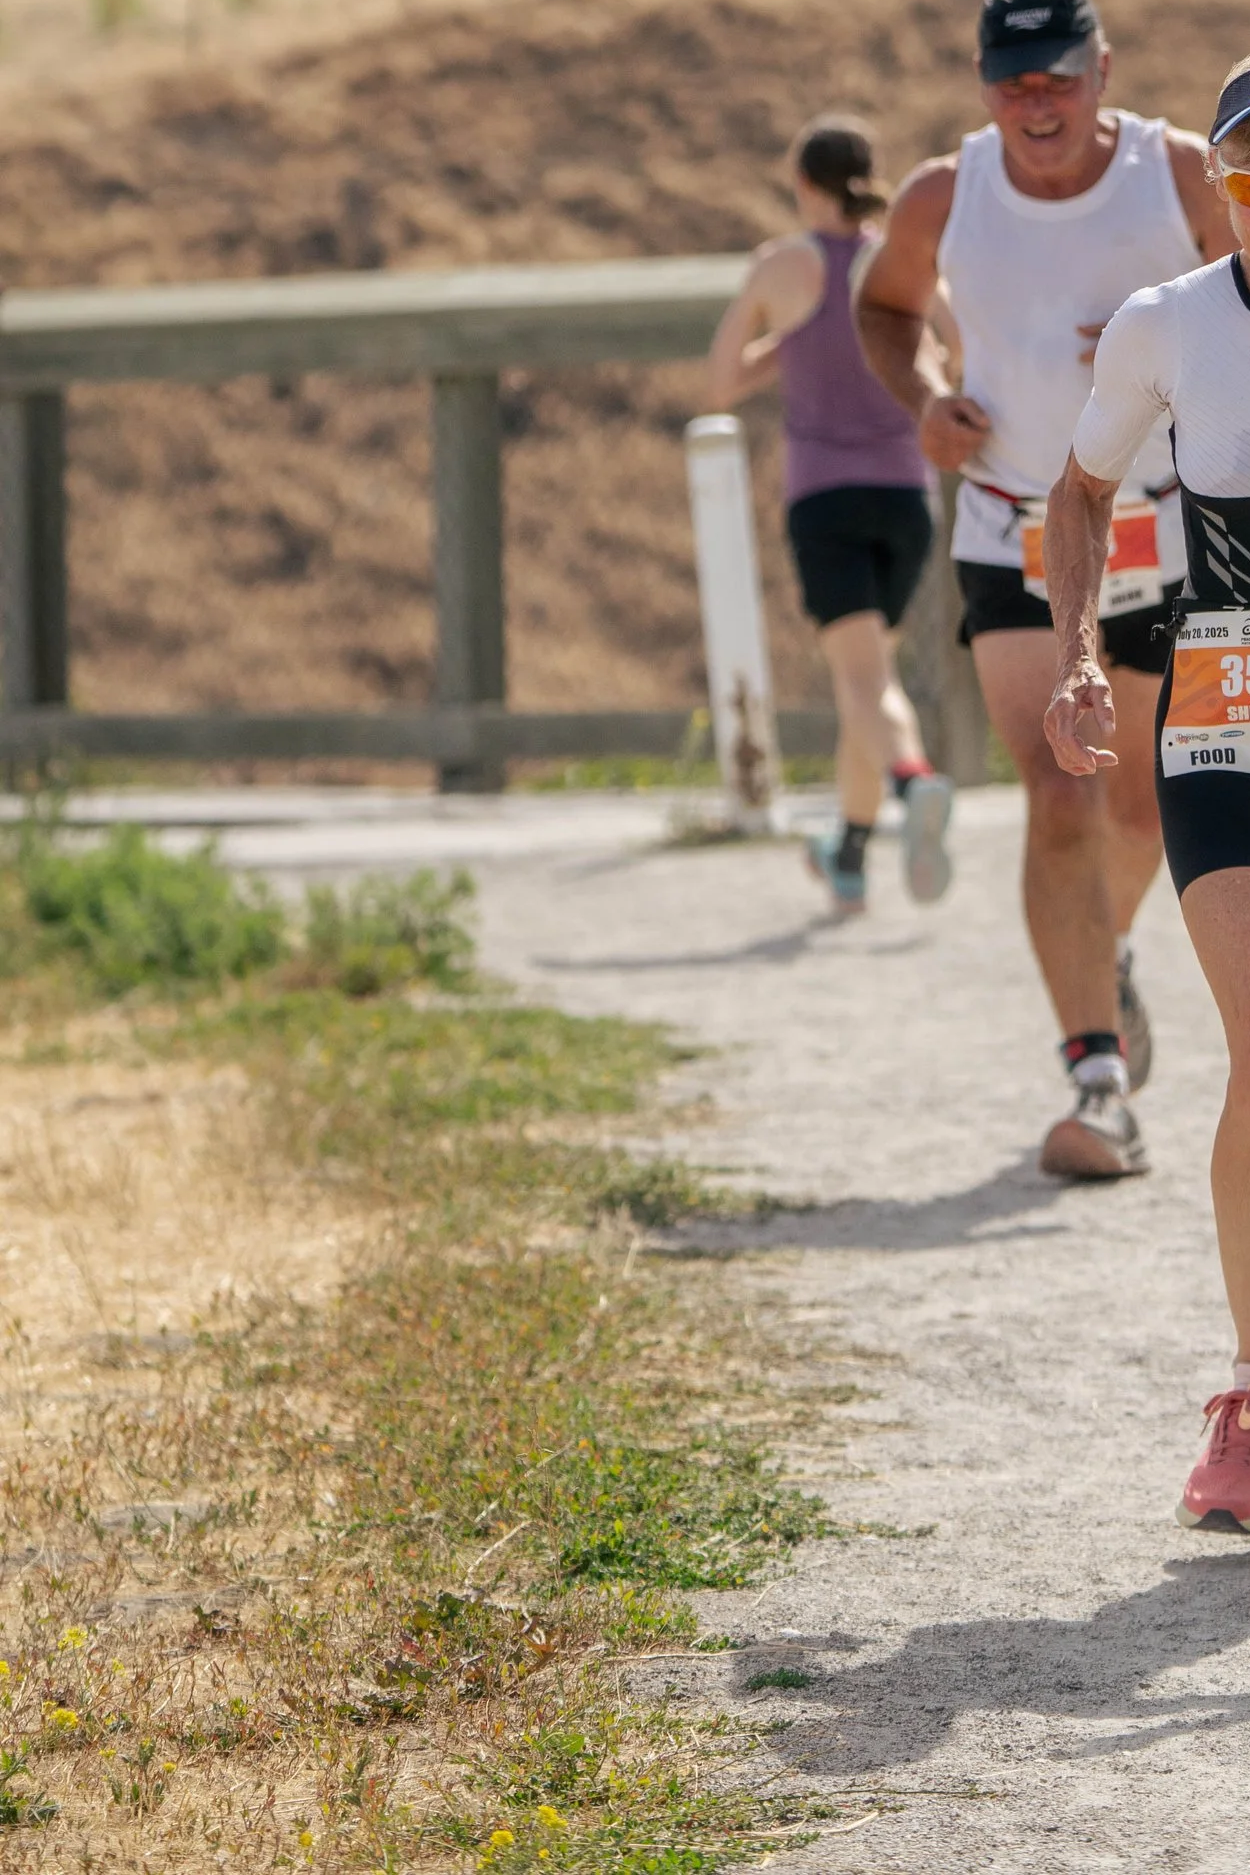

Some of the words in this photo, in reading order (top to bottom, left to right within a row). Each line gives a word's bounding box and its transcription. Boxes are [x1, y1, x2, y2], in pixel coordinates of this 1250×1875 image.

[1192, 627, 1204, 640] 20,
[1205, 626, 1229, 638] 2025
[1190, 747, 1236, 766] FOOD
